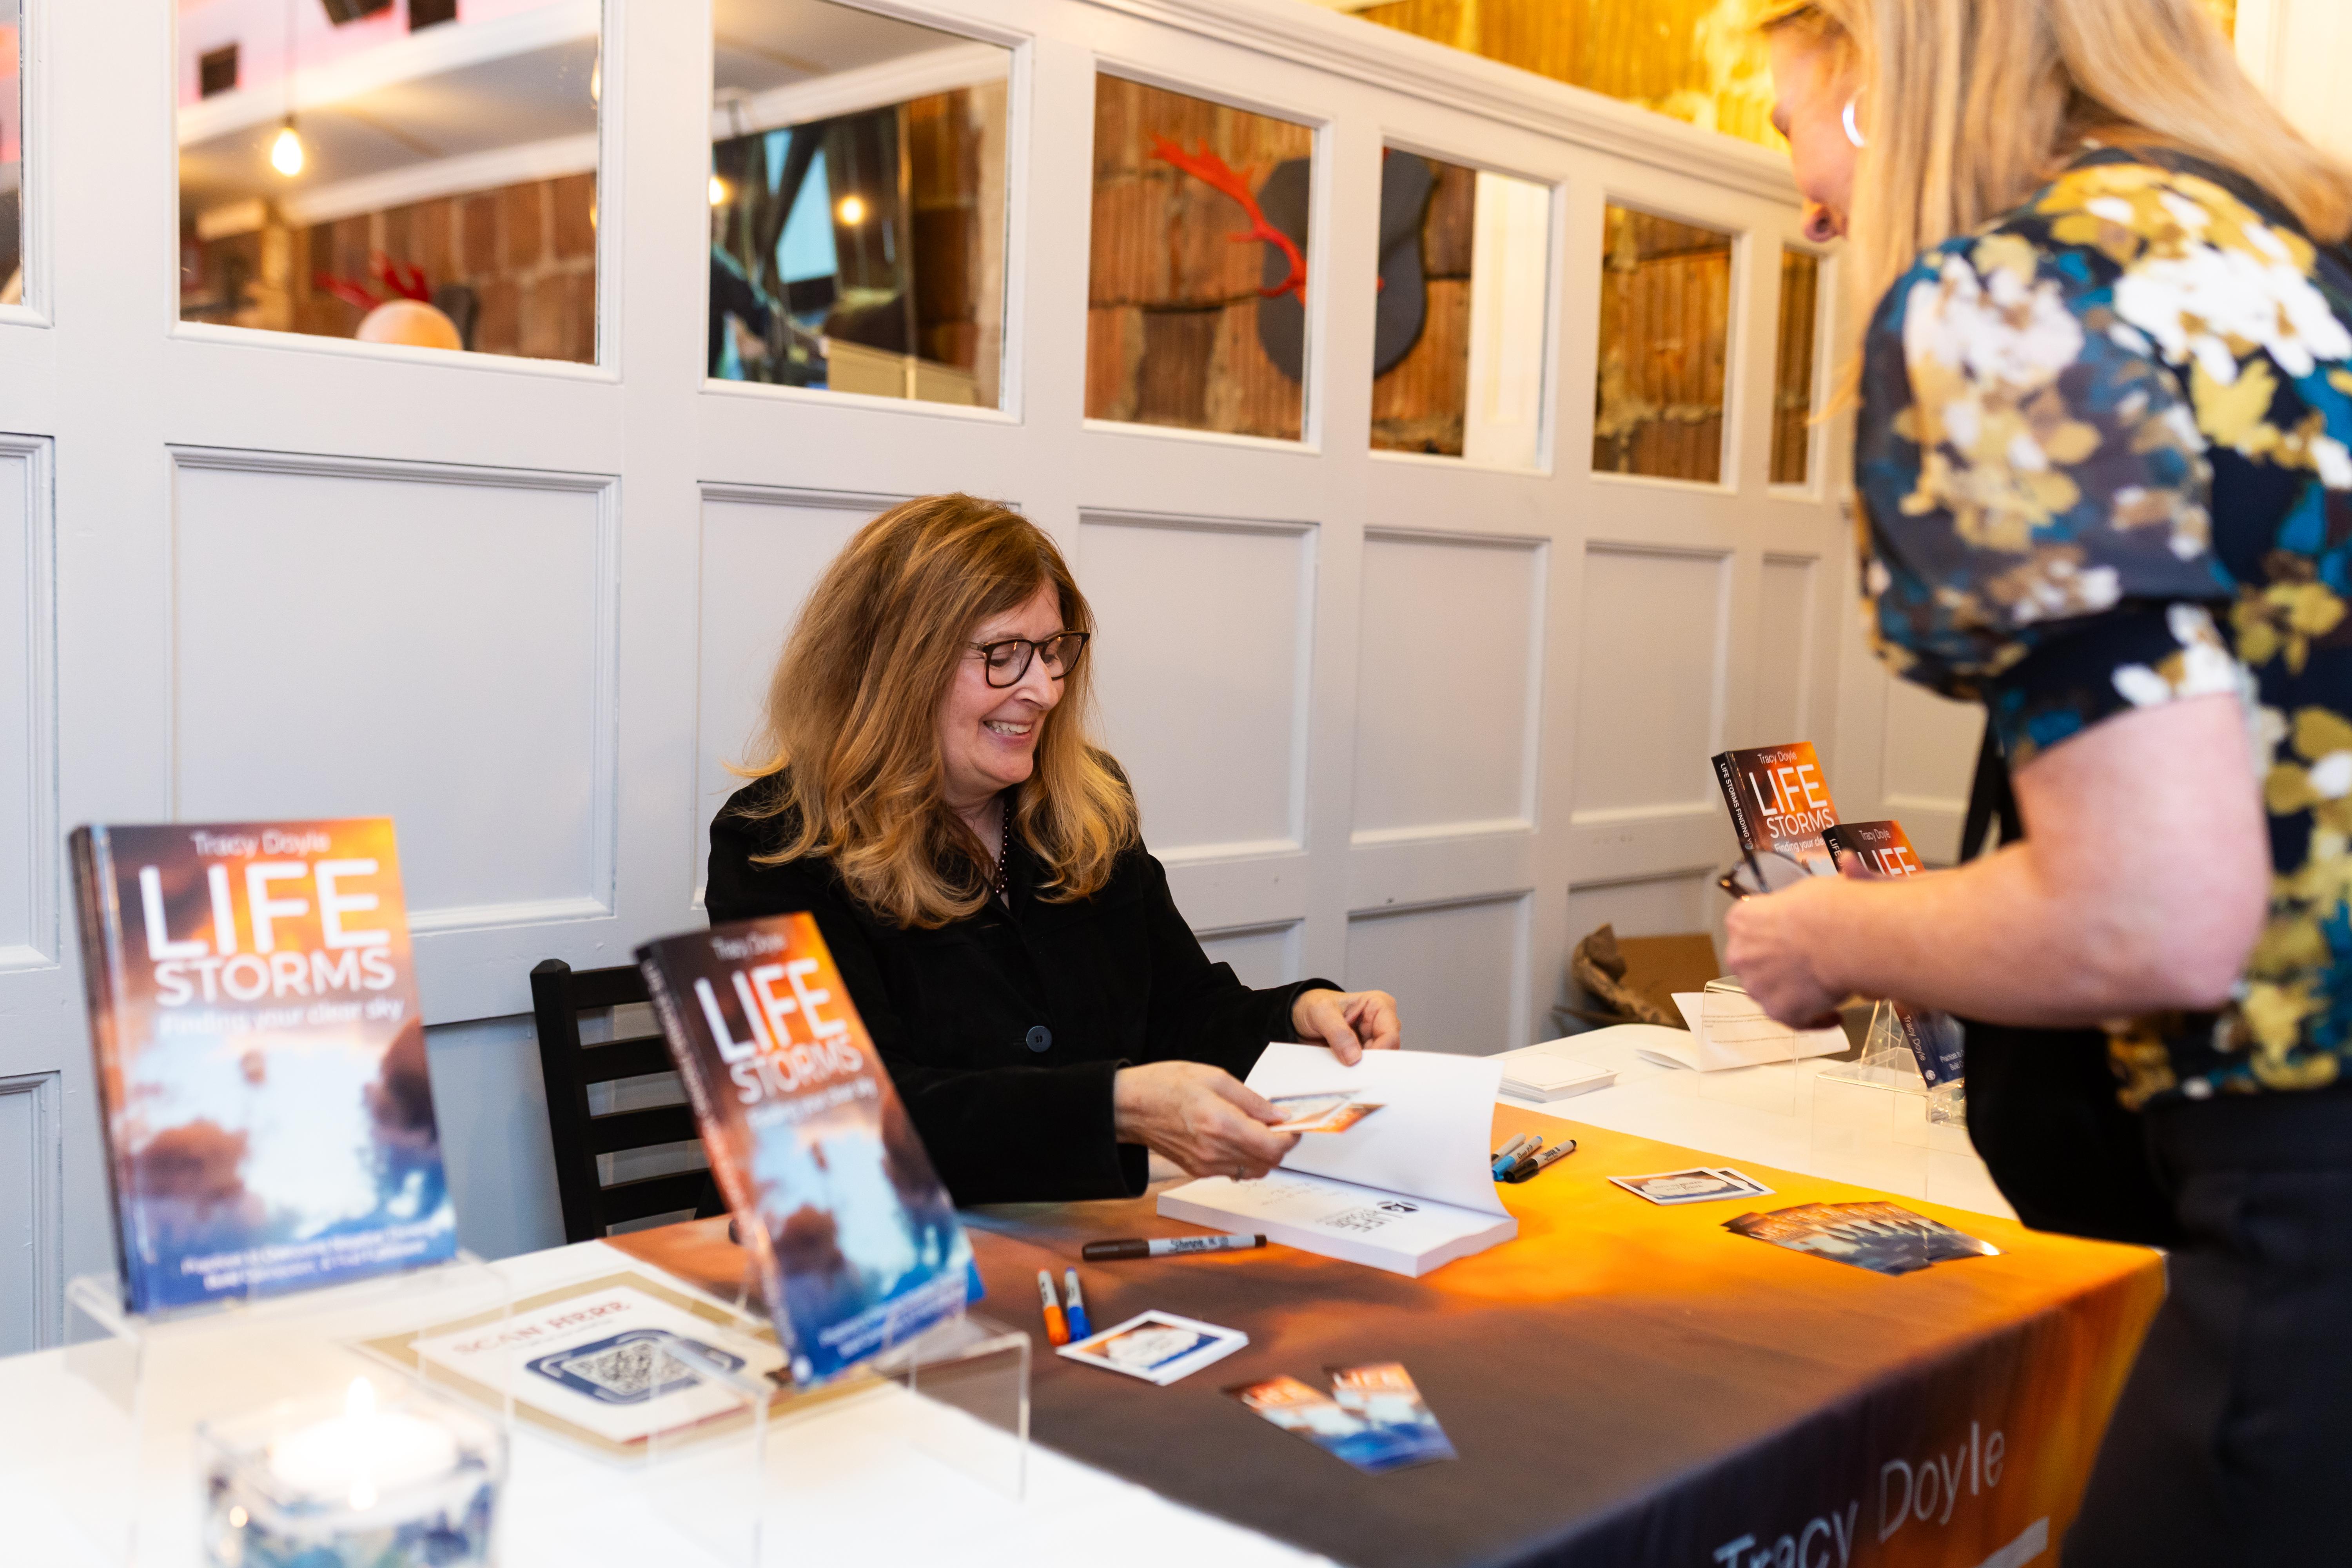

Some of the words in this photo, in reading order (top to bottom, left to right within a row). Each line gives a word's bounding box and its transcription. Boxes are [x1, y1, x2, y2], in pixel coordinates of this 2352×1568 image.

[1757, 753, 1777, 764] Tracy
[1777, 751, 1797, 763] Doyle
[1720, 762, 1730, 779] LIFE
[1726, 778, 1739, 808] STORMS
[1736, 808, 1749, 838] FINDING
[1749, 764, 1827, 816] LIFE
[191, 830, 259, 859] Tracy
[1766, 808, 1835, 839] STORMS
[1774, 840, 1800, 852] Finding
[1798, 839, 1815, 851] your
[1815, 836, 1825, 847] cle
[1829, 838, 1842, 857] LIFE
[1858, 830, 1876, 842] Tracy
[1874, 829, 1891, 840] Doyle
[140, 858, 390, 961] LIFE
[154, 948, 396, 1007] STORMS
[694, 957, 846, 1063] LIFE
[1904, 1014, 1916, 1036] Tracy
[1912, 1039, 1926, 1061] Doyle
[730, 1034, 862, 1104] STORMS
[1879, 1421, 2005, 1543] Doyle
